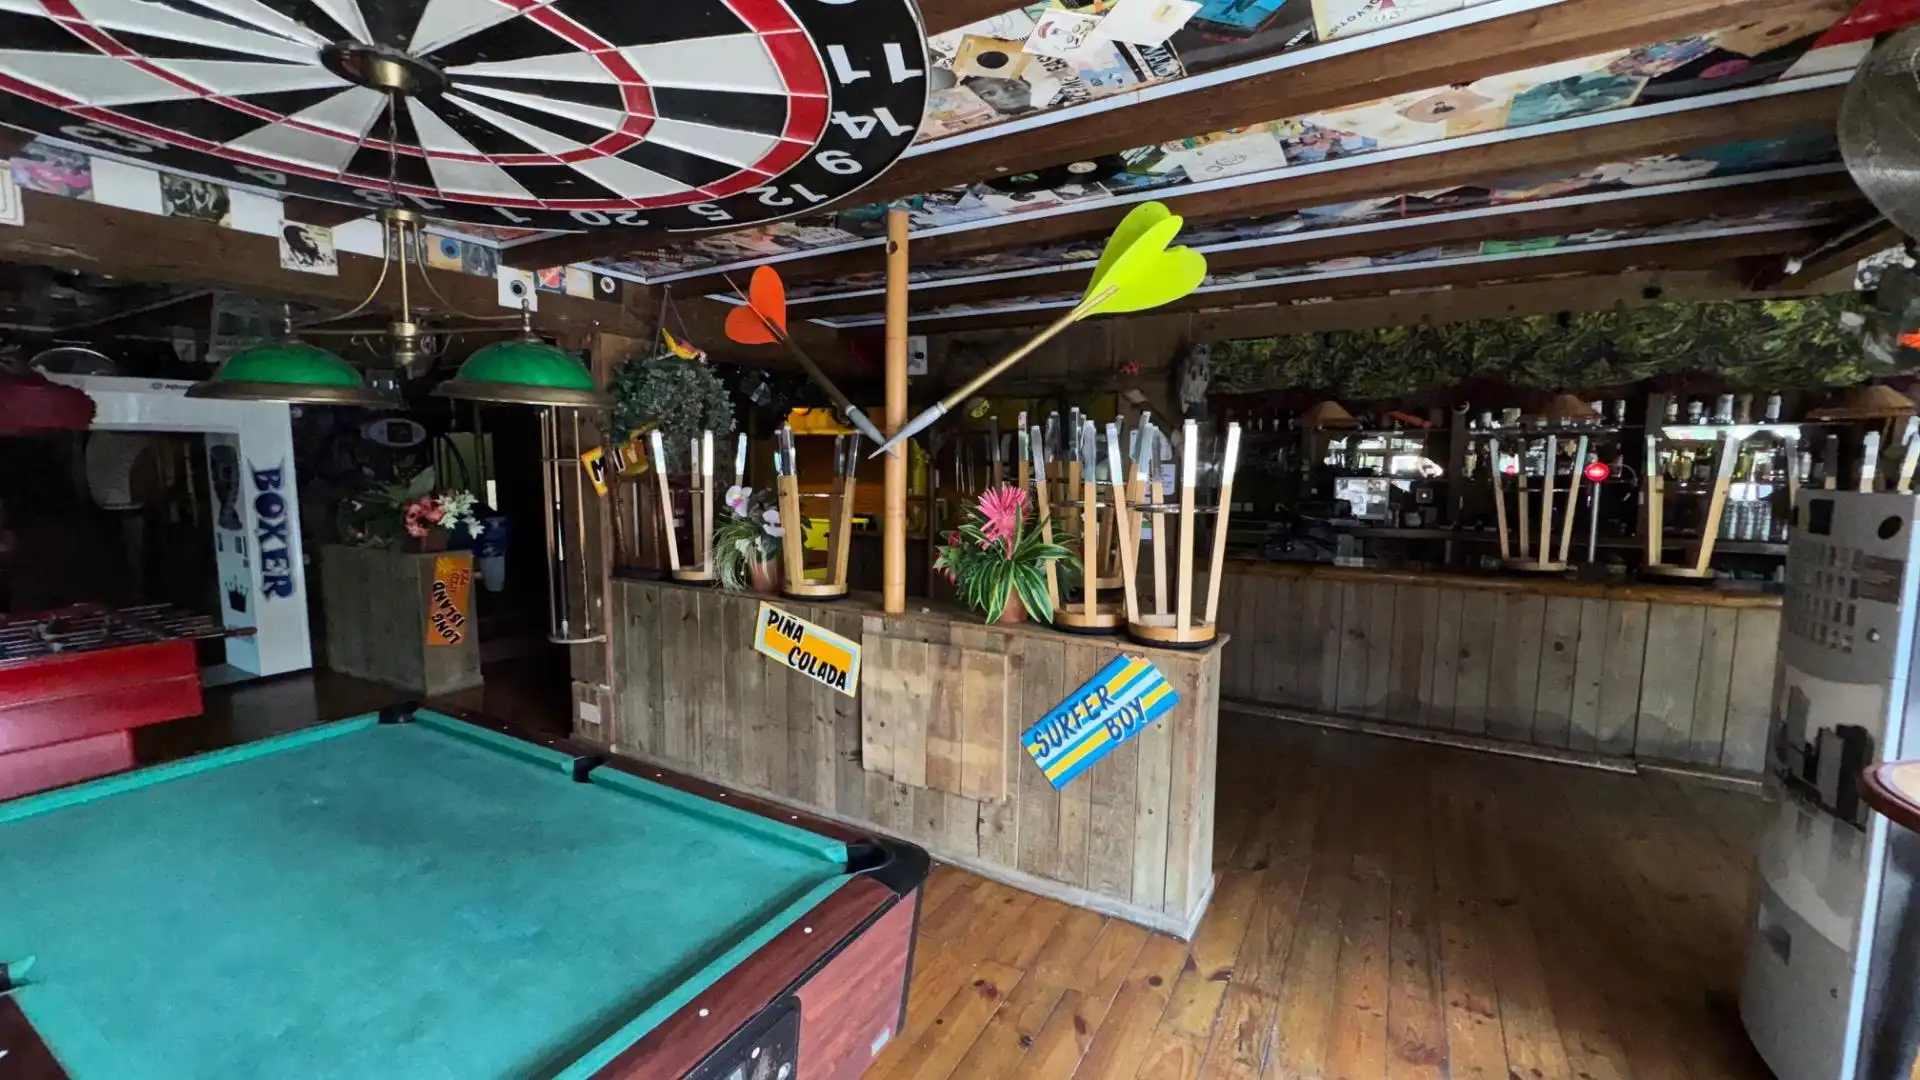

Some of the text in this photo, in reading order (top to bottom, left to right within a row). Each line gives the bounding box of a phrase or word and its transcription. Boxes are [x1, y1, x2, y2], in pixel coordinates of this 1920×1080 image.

[826, 43, 923, 84] 11
[831, 107, 915, 140] 14
[687, 203, 734, 222] 5
[745, 184, 828, 206] 12
[494, 206, 532, 224] 1
[569, 209, 650, 227] 20
[249, 459, 293, 601] BOXER
[433, 580, 465, 628] ISLAND
[432, 611, 461, 645] LONG
[767, 608, 805, 643] PIÑA
[787, 646, 847, 691] COLADA
[1032, 684, 1116, 758] SURFER
[1103, 695, 1148, 742] BOY
